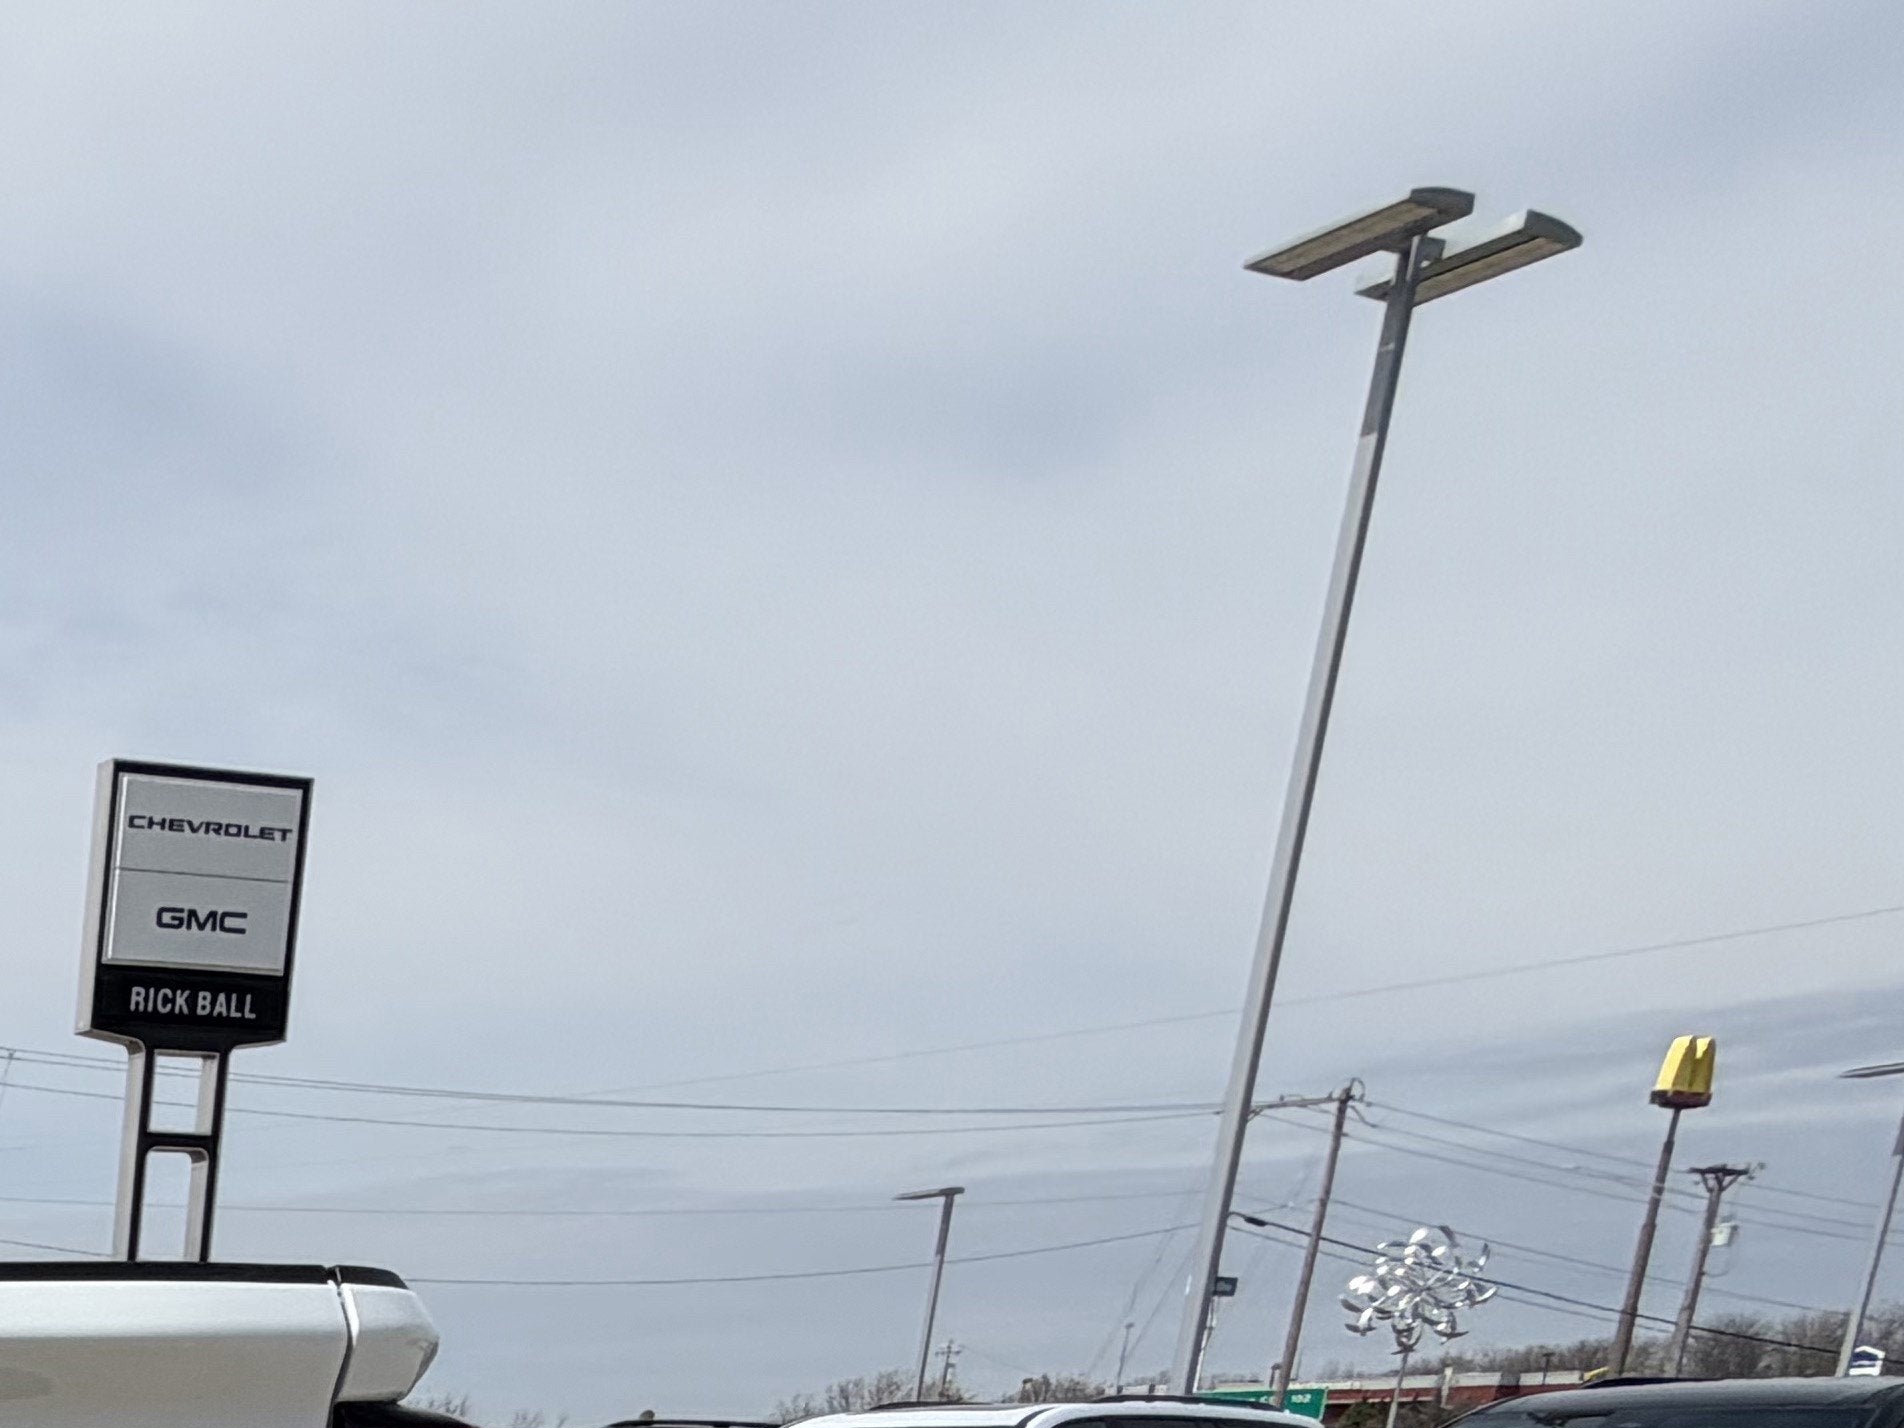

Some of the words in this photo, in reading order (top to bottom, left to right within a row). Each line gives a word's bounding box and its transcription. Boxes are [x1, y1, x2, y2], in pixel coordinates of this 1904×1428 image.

[127, 814, 293, 842] CHEVROLET
[155, 906, 248, 935] GMC
[129, 986, 191, 1015] RICK
[196, 990, 257, 1019] BALL
